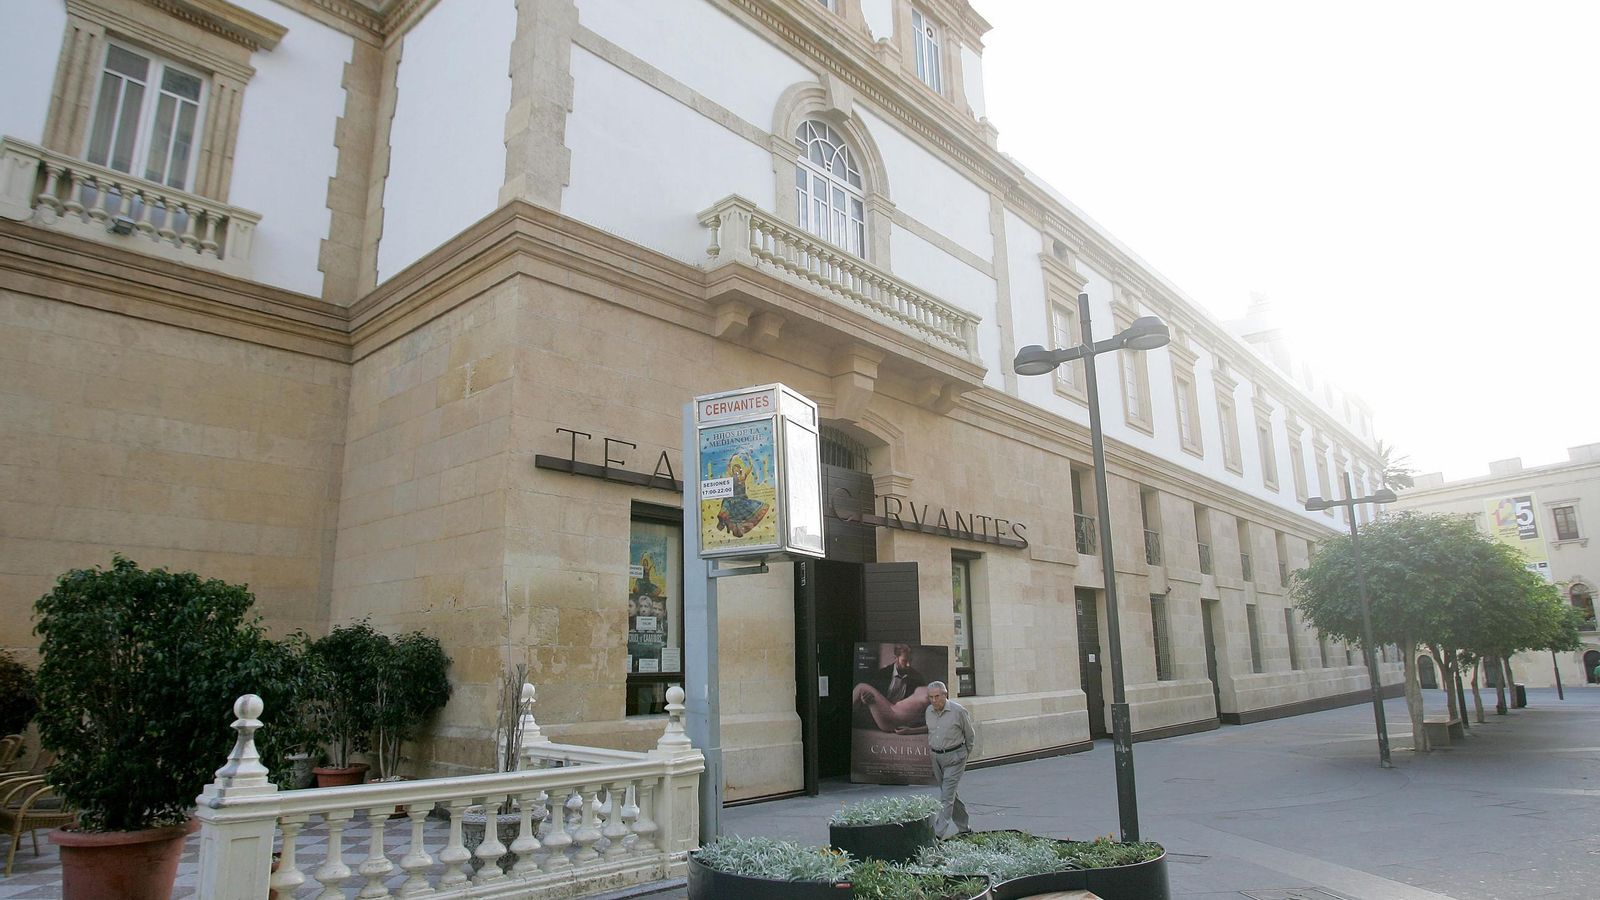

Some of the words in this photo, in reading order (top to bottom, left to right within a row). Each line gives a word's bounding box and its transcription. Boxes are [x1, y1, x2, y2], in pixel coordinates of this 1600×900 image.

[705, 395, 769, 416] CERVANTES
[709, 434, 764, 448] MEDIANOCHE
[713, 431, 735, 441] HIJOS
[737, 428, 748, 436] DE
[749, 427, 760, 435] LA
[556, 427, 680, 494] TEA
[831, 487, 1029, 550] CERVANTES
[703, 480, 730, 488] SESIONES
[702, 487, 732, 496] 17:00-22:00
